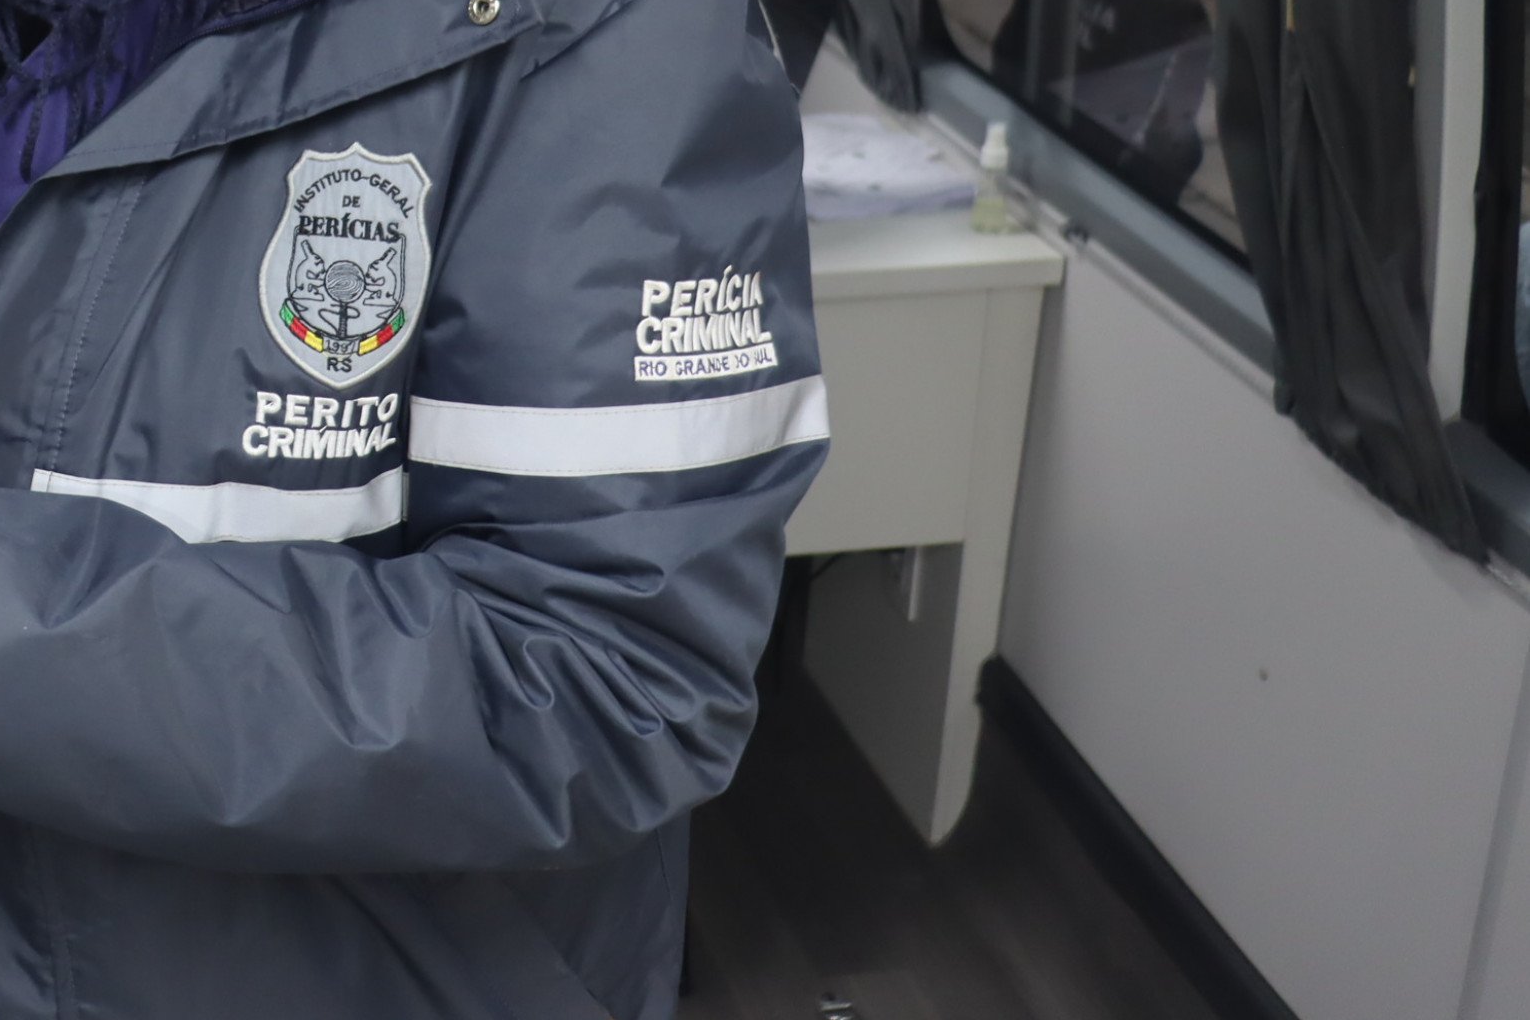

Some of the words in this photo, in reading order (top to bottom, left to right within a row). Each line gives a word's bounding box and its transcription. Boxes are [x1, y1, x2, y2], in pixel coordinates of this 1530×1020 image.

[342, 195, 361, 208] DE
[298, 212, 402, 244] PERÍCIAS
[641, 265, 764, 317] PERÍCIA
[635, 308, 773, 354] CRIMINAL
[326, 356, 352, 373] RS
[638, 361, 668, 377] RIO
[255, 391, 399, 429] PERITO
[242, 415, 397, 460] CRIMINAL
